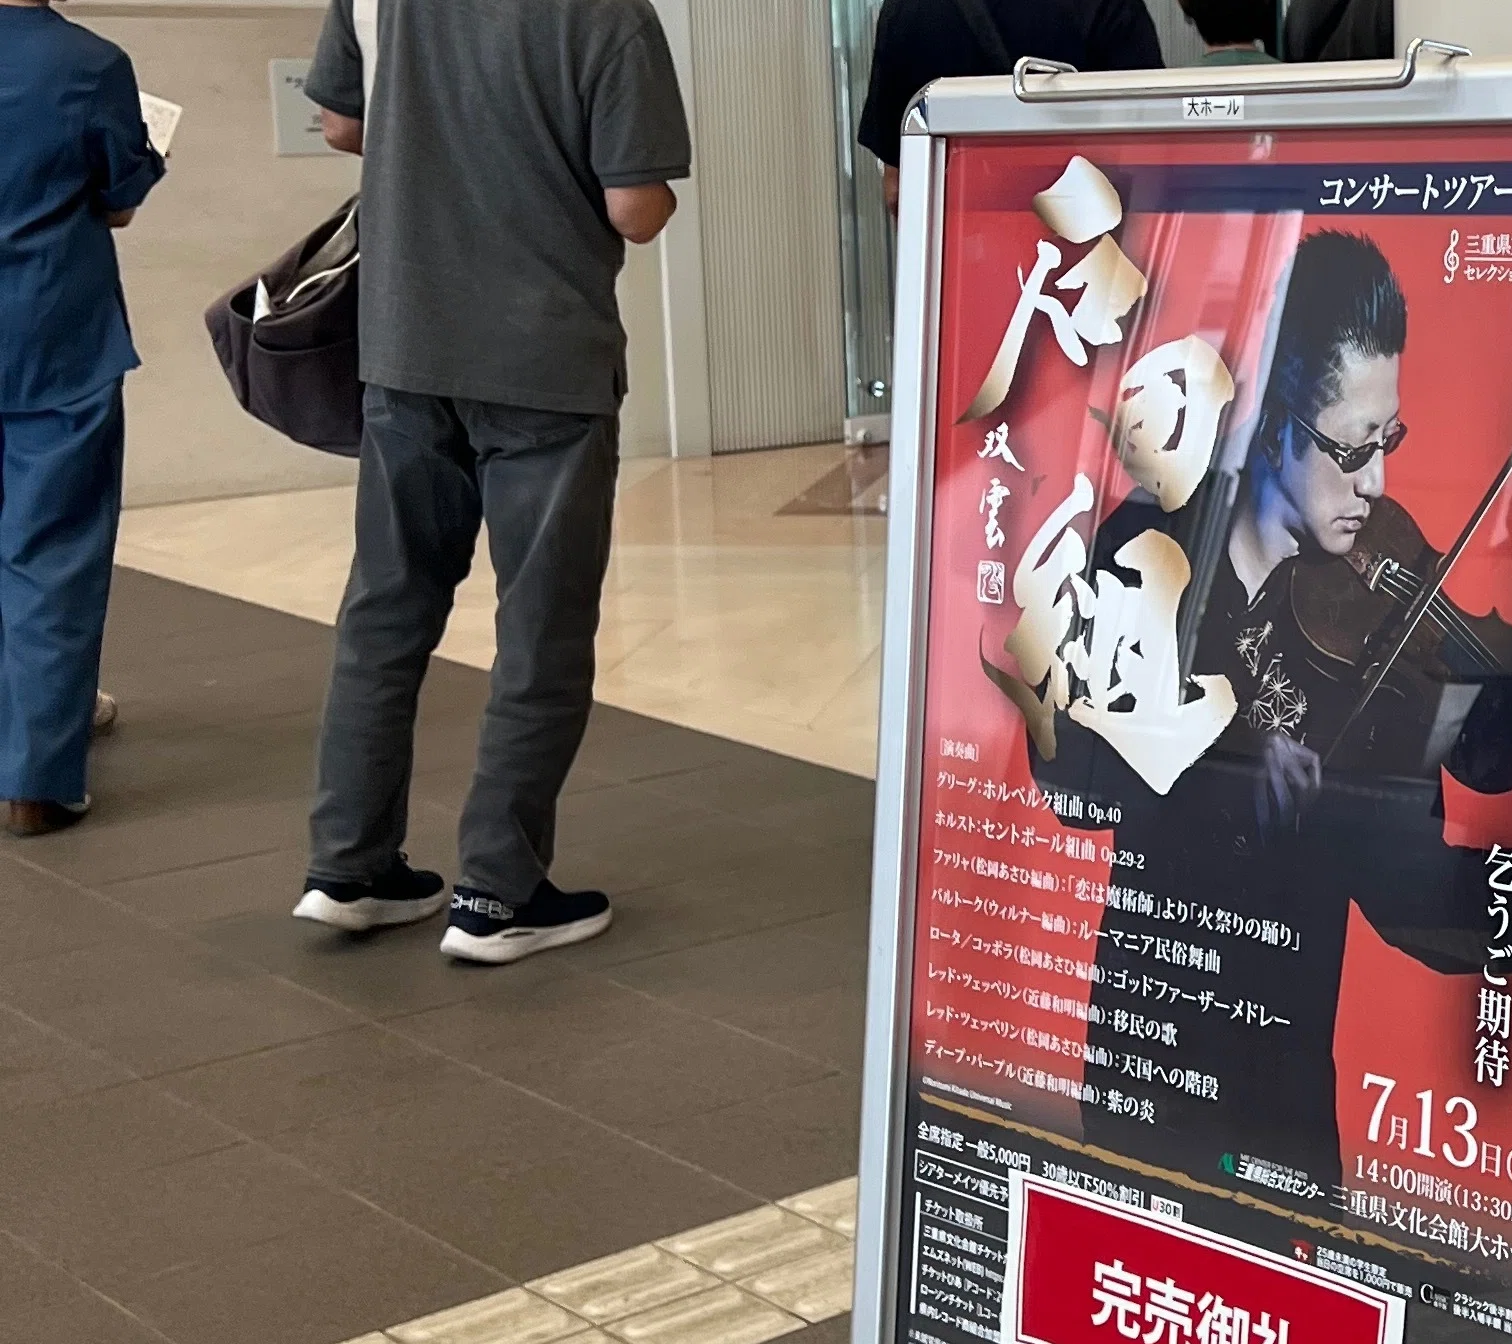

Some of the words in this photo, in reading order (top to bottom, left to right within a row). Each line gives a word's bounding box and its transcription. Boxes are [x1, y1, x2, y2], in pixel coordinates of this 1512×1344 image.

[1187, 98, 1240, 116] 大ホール
[1088, 801, 1122, 825] Op.40
[1100, 844, 1145, 870] Op.29-2
[917, 1120, 964, 1152] 全席指定
